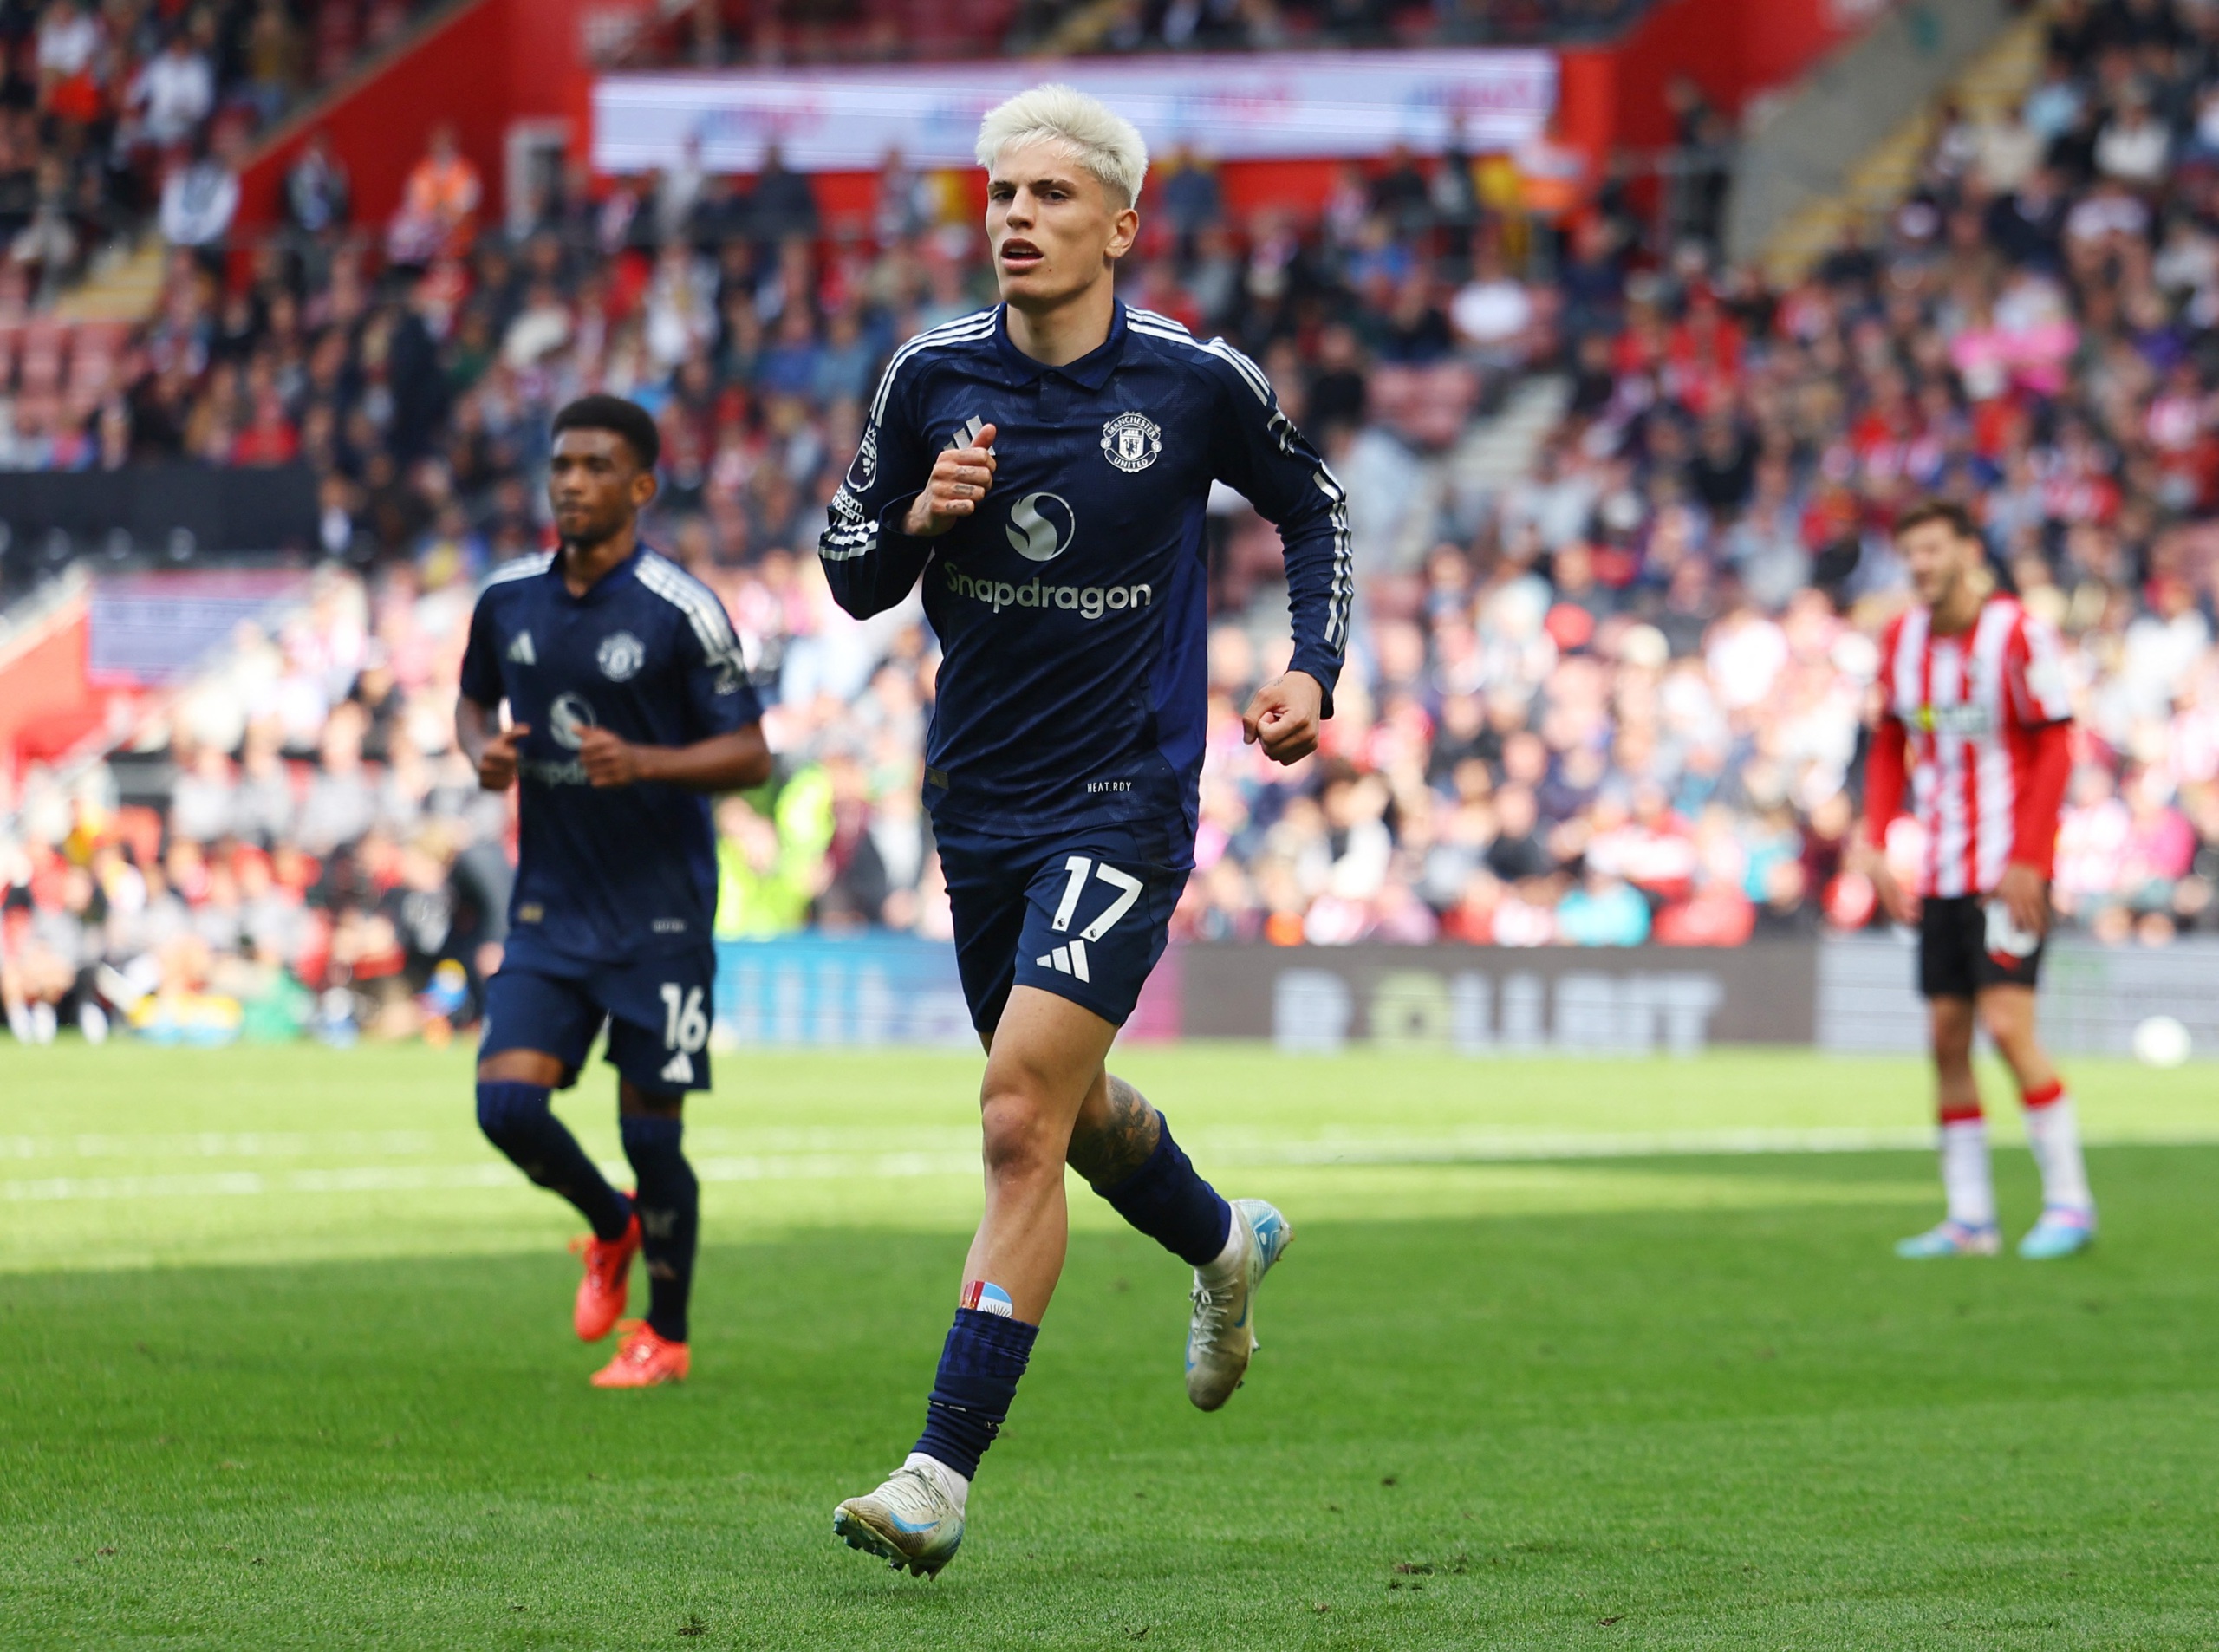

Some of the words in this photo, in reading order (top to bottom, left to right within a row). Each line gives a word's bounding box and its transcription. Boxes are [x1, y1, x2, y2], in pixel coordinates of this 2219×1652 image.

[1107, 416, 1156, 438] MANCHESTER
[1113, 456, 1149, 469] UNITED
[833, 497, 865, 524] racism
[839, 488, 863, 513] room
[944, 561, 1152, 620] Snapdragon
[1087, 781, 1132, 793] HEAT.RDY
[1051, 855, 1144, 943] 17
[660, 981, 709, 1055] 16
